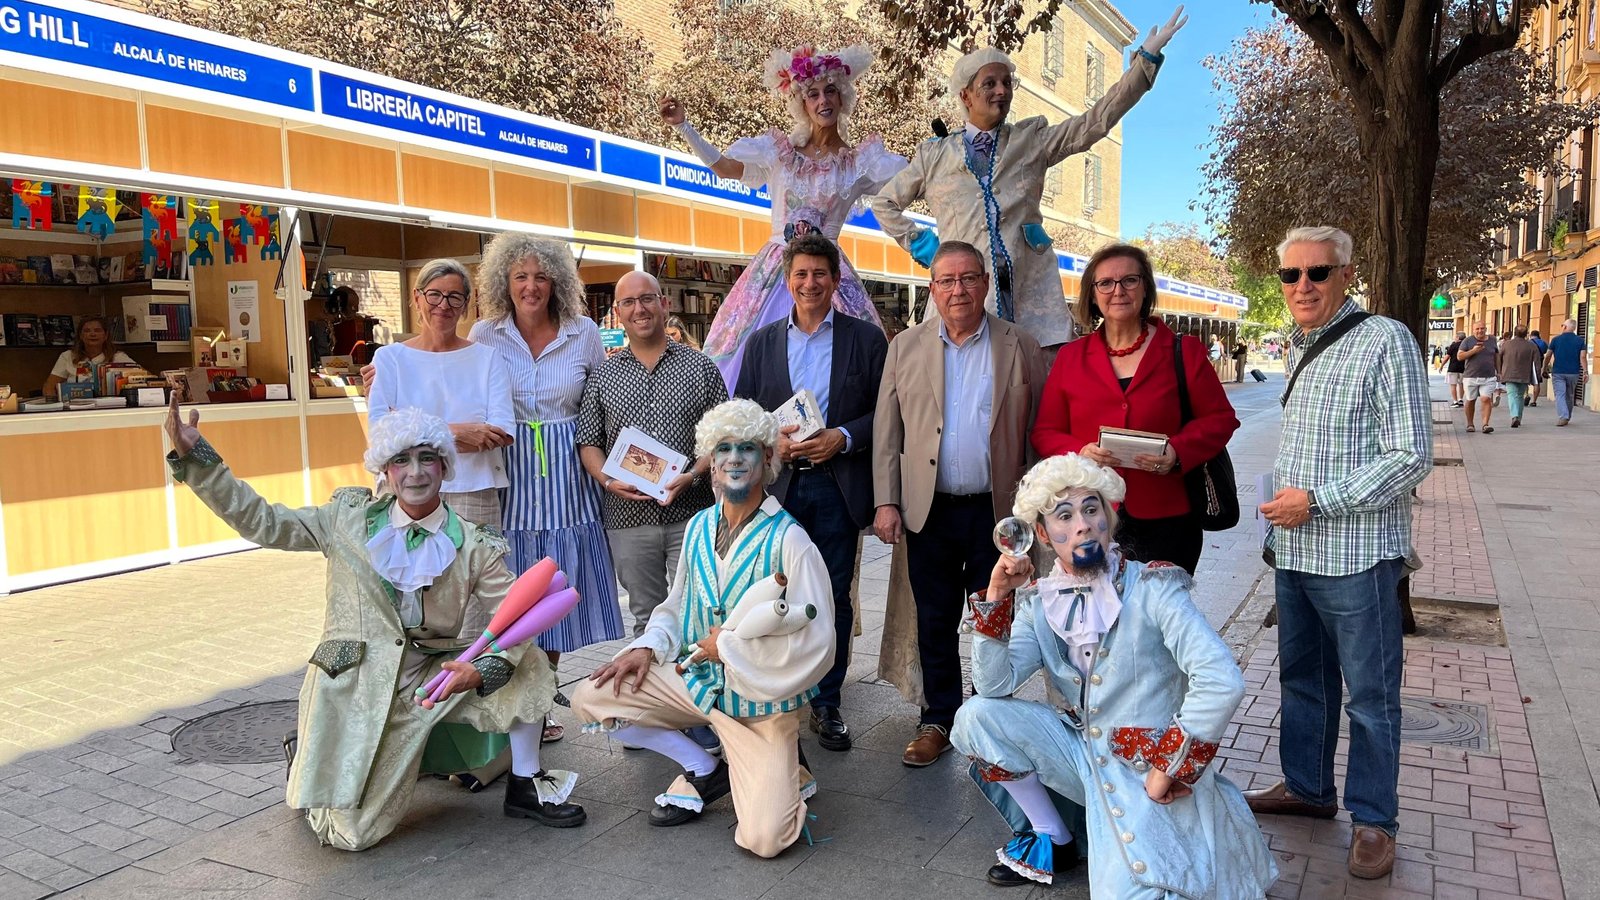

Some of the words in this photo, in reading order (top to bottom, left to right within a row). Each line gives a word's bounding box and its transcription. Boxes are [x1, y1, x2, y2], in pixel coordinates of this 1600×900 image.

[0, 6, 21, 34] G
[28, 11, 89, 48] HILL
[113, 41, 166, 65] ALCALÁ
[168, 54, 186, 69] DE
[188, 58, 247, 82] HENARES
[288, 78, 297, 94] 6
[346, 86, 423, 122] LIBRERÍA
[425, 105, 486, 137] CAPITEL
[499, 129, 527, 146] ALCALÁ
[527, 136, 537, 148] DE
[537, 138, 568, 154] HENARES
[585, 147, 591, 159] 7
[667, 163, 712, 187] DOMIDUCA
